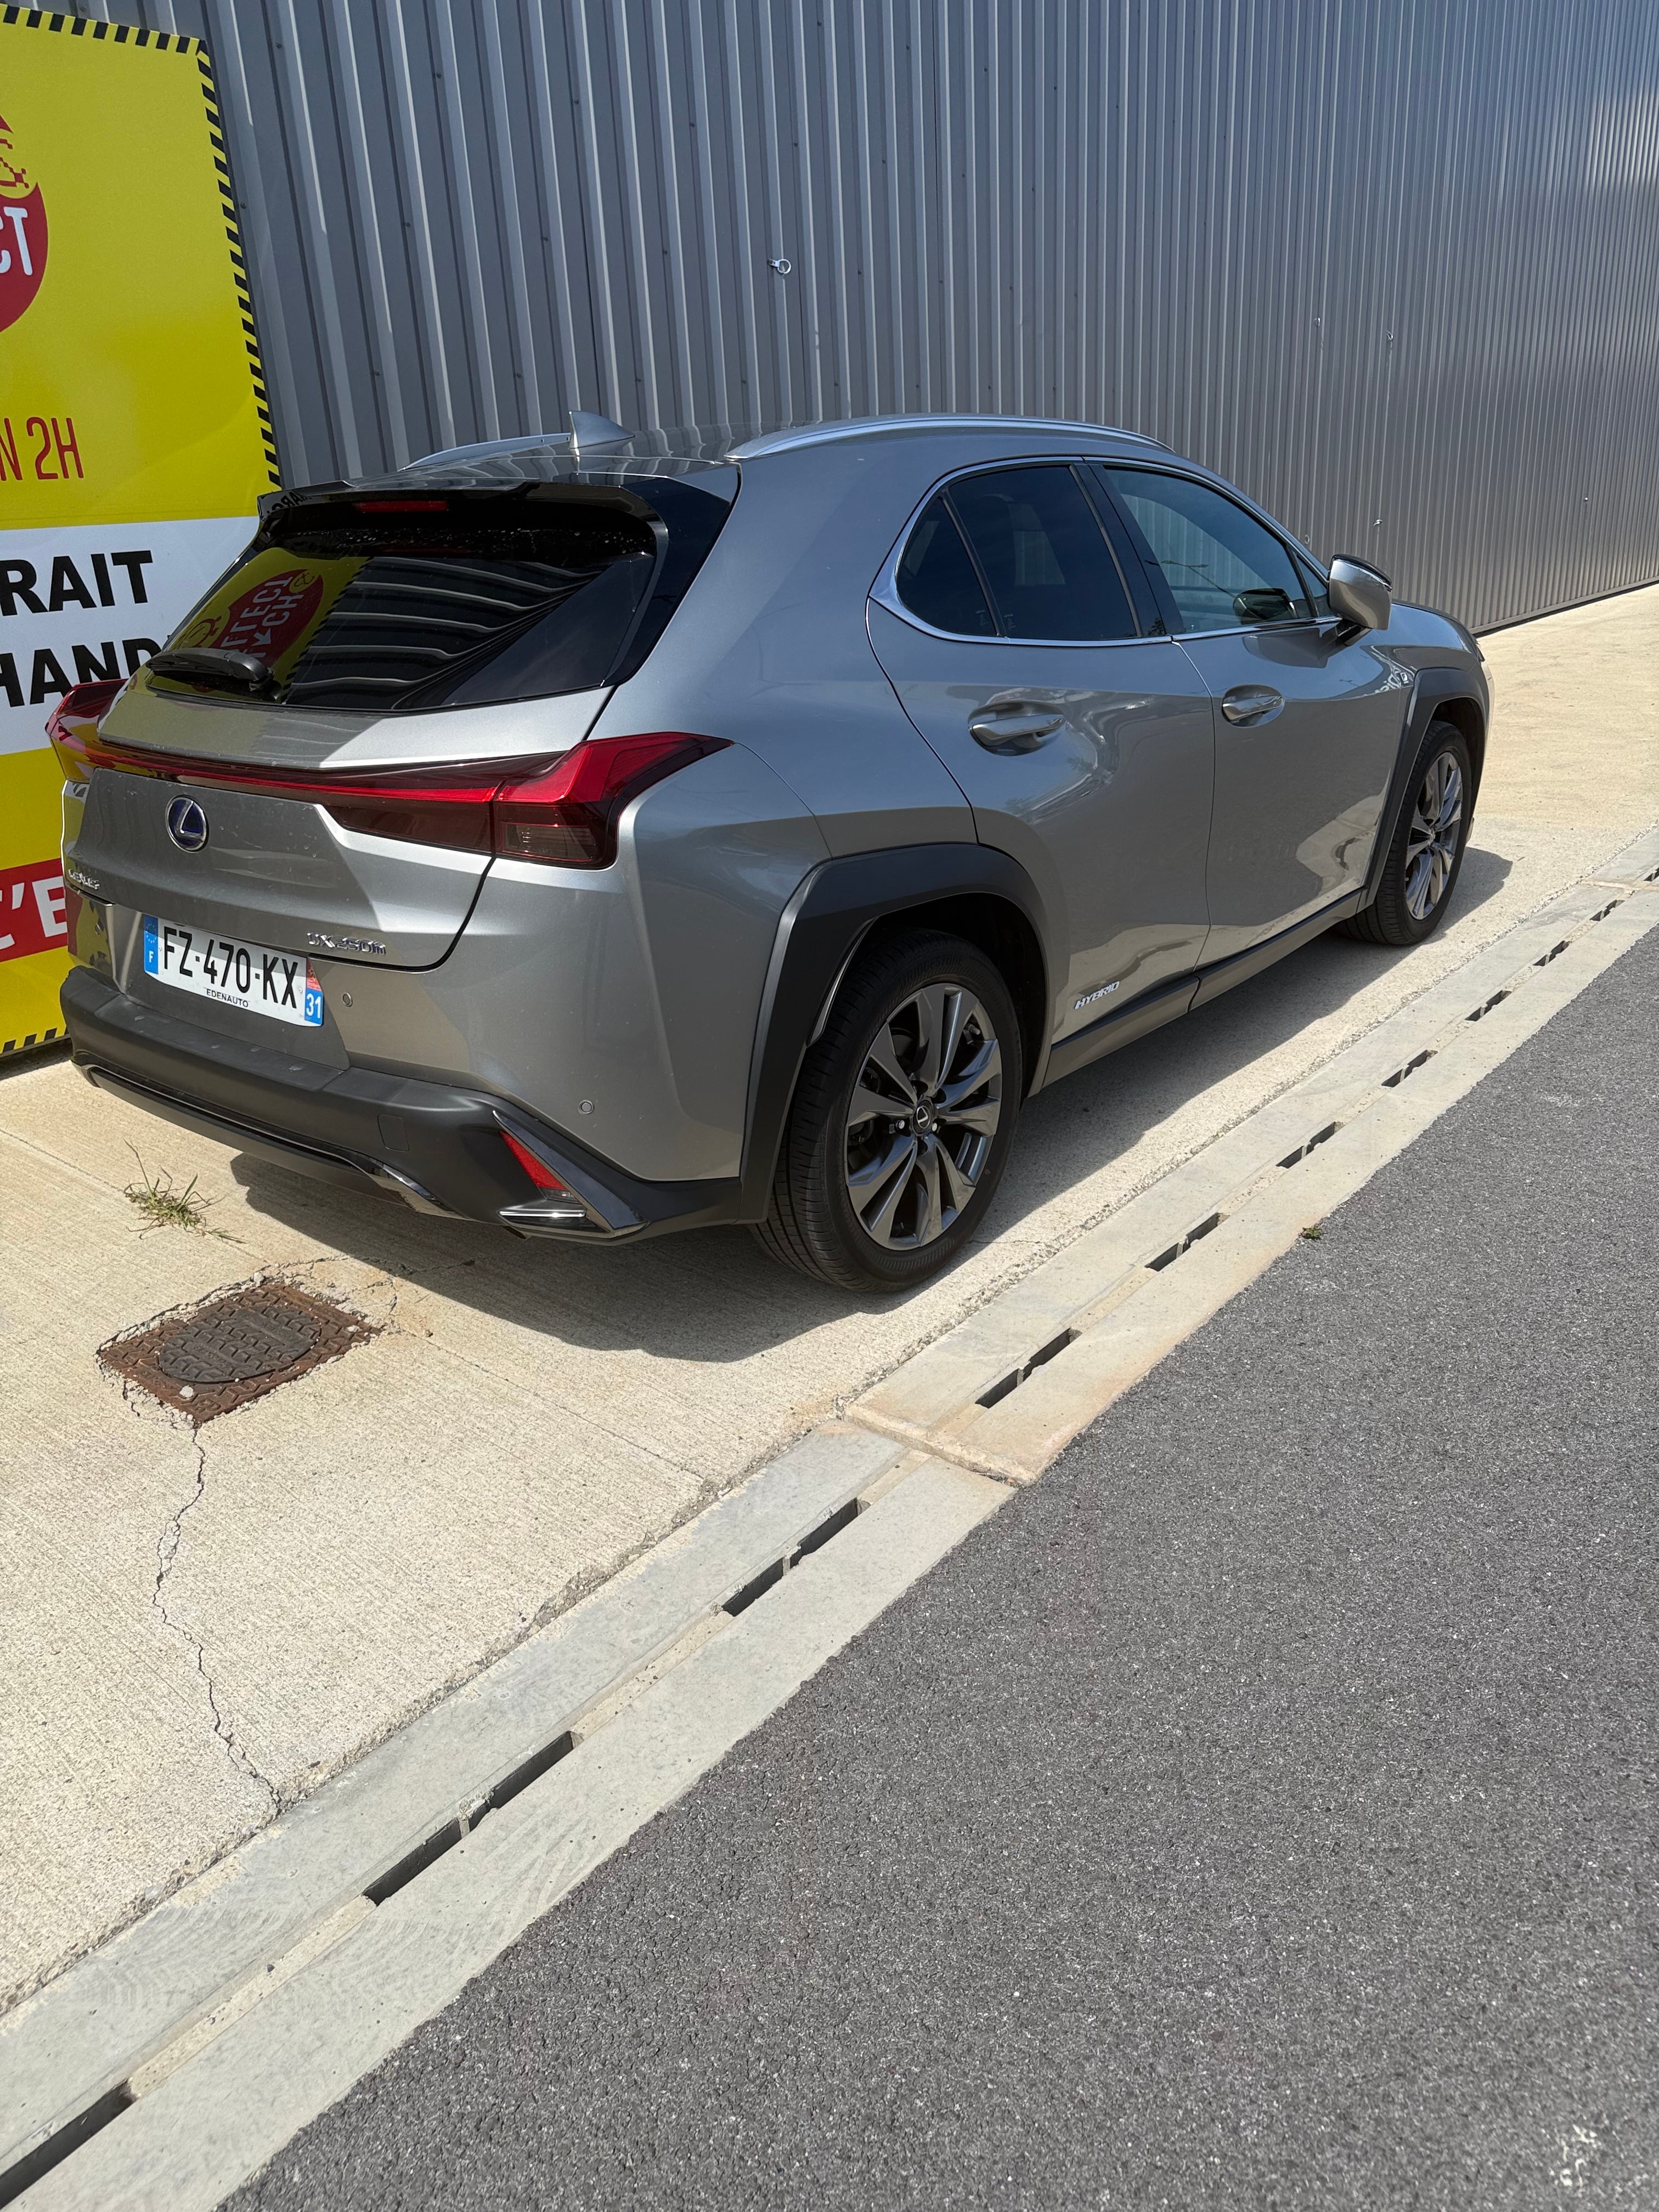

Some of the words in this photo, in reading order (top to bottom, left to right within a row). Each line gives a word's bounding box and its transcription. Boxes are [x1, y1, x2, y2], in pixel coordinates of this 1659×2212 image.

[26, 417, 84, 480] 2H
[0, 550, 153, 616] RAIT
[149, 950, 154, 963] F
[164, 926, 298, 1009] FZ-470-KX
[306, 993, 321, 1019] 31
[206, 989, 249, 1008] EDENAUTO
[1075, 981, 1120, 1009] HYBRID
